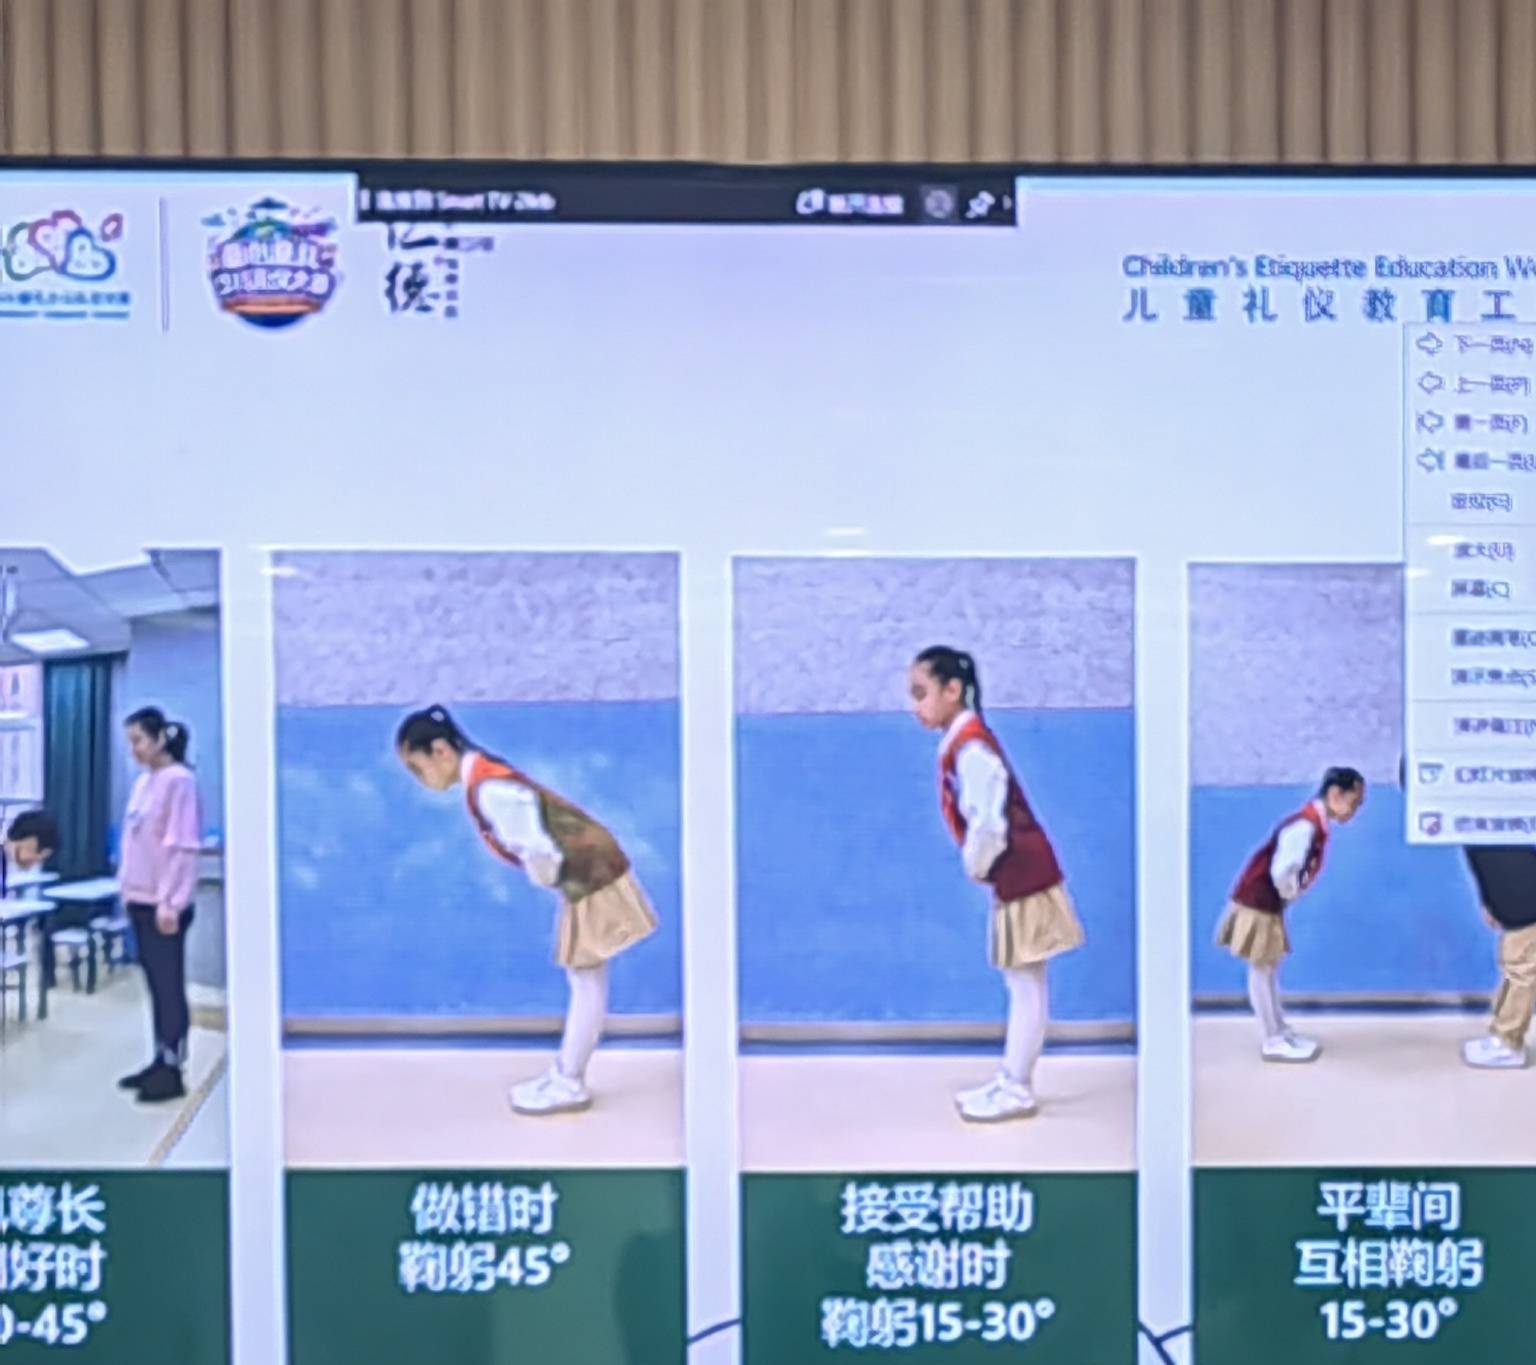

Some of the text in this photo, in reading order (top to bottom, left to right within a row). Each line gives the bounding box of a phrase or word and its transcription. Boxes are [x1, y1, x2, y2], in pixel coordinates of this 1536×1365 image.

[1123, 254, 1248, 278] Children's
[1255, 255, 1367, 283] Etiquette
[1375, 255, 1497, 279] Education
[0, 1182, 106, 1235] 尊长
[411, 1181, 559, 1234] 做错时
[841, 1182, 1033, 1234] 接受帮助
[1317, 1181, 1460, 1231] 平辈间
[0, 1240, 107, 1292] 好时
[399, 1241, 571, 1292] 鞠躬45°
[866, 1239, 1011, 1290] 感谢时
[1294, 1237, 1483, 1288] 互相鞠躬
[822, 1299, 1055, 1348] 鞠躬15-30°
[1320, 1297, 1458, 1340] 15-30°
